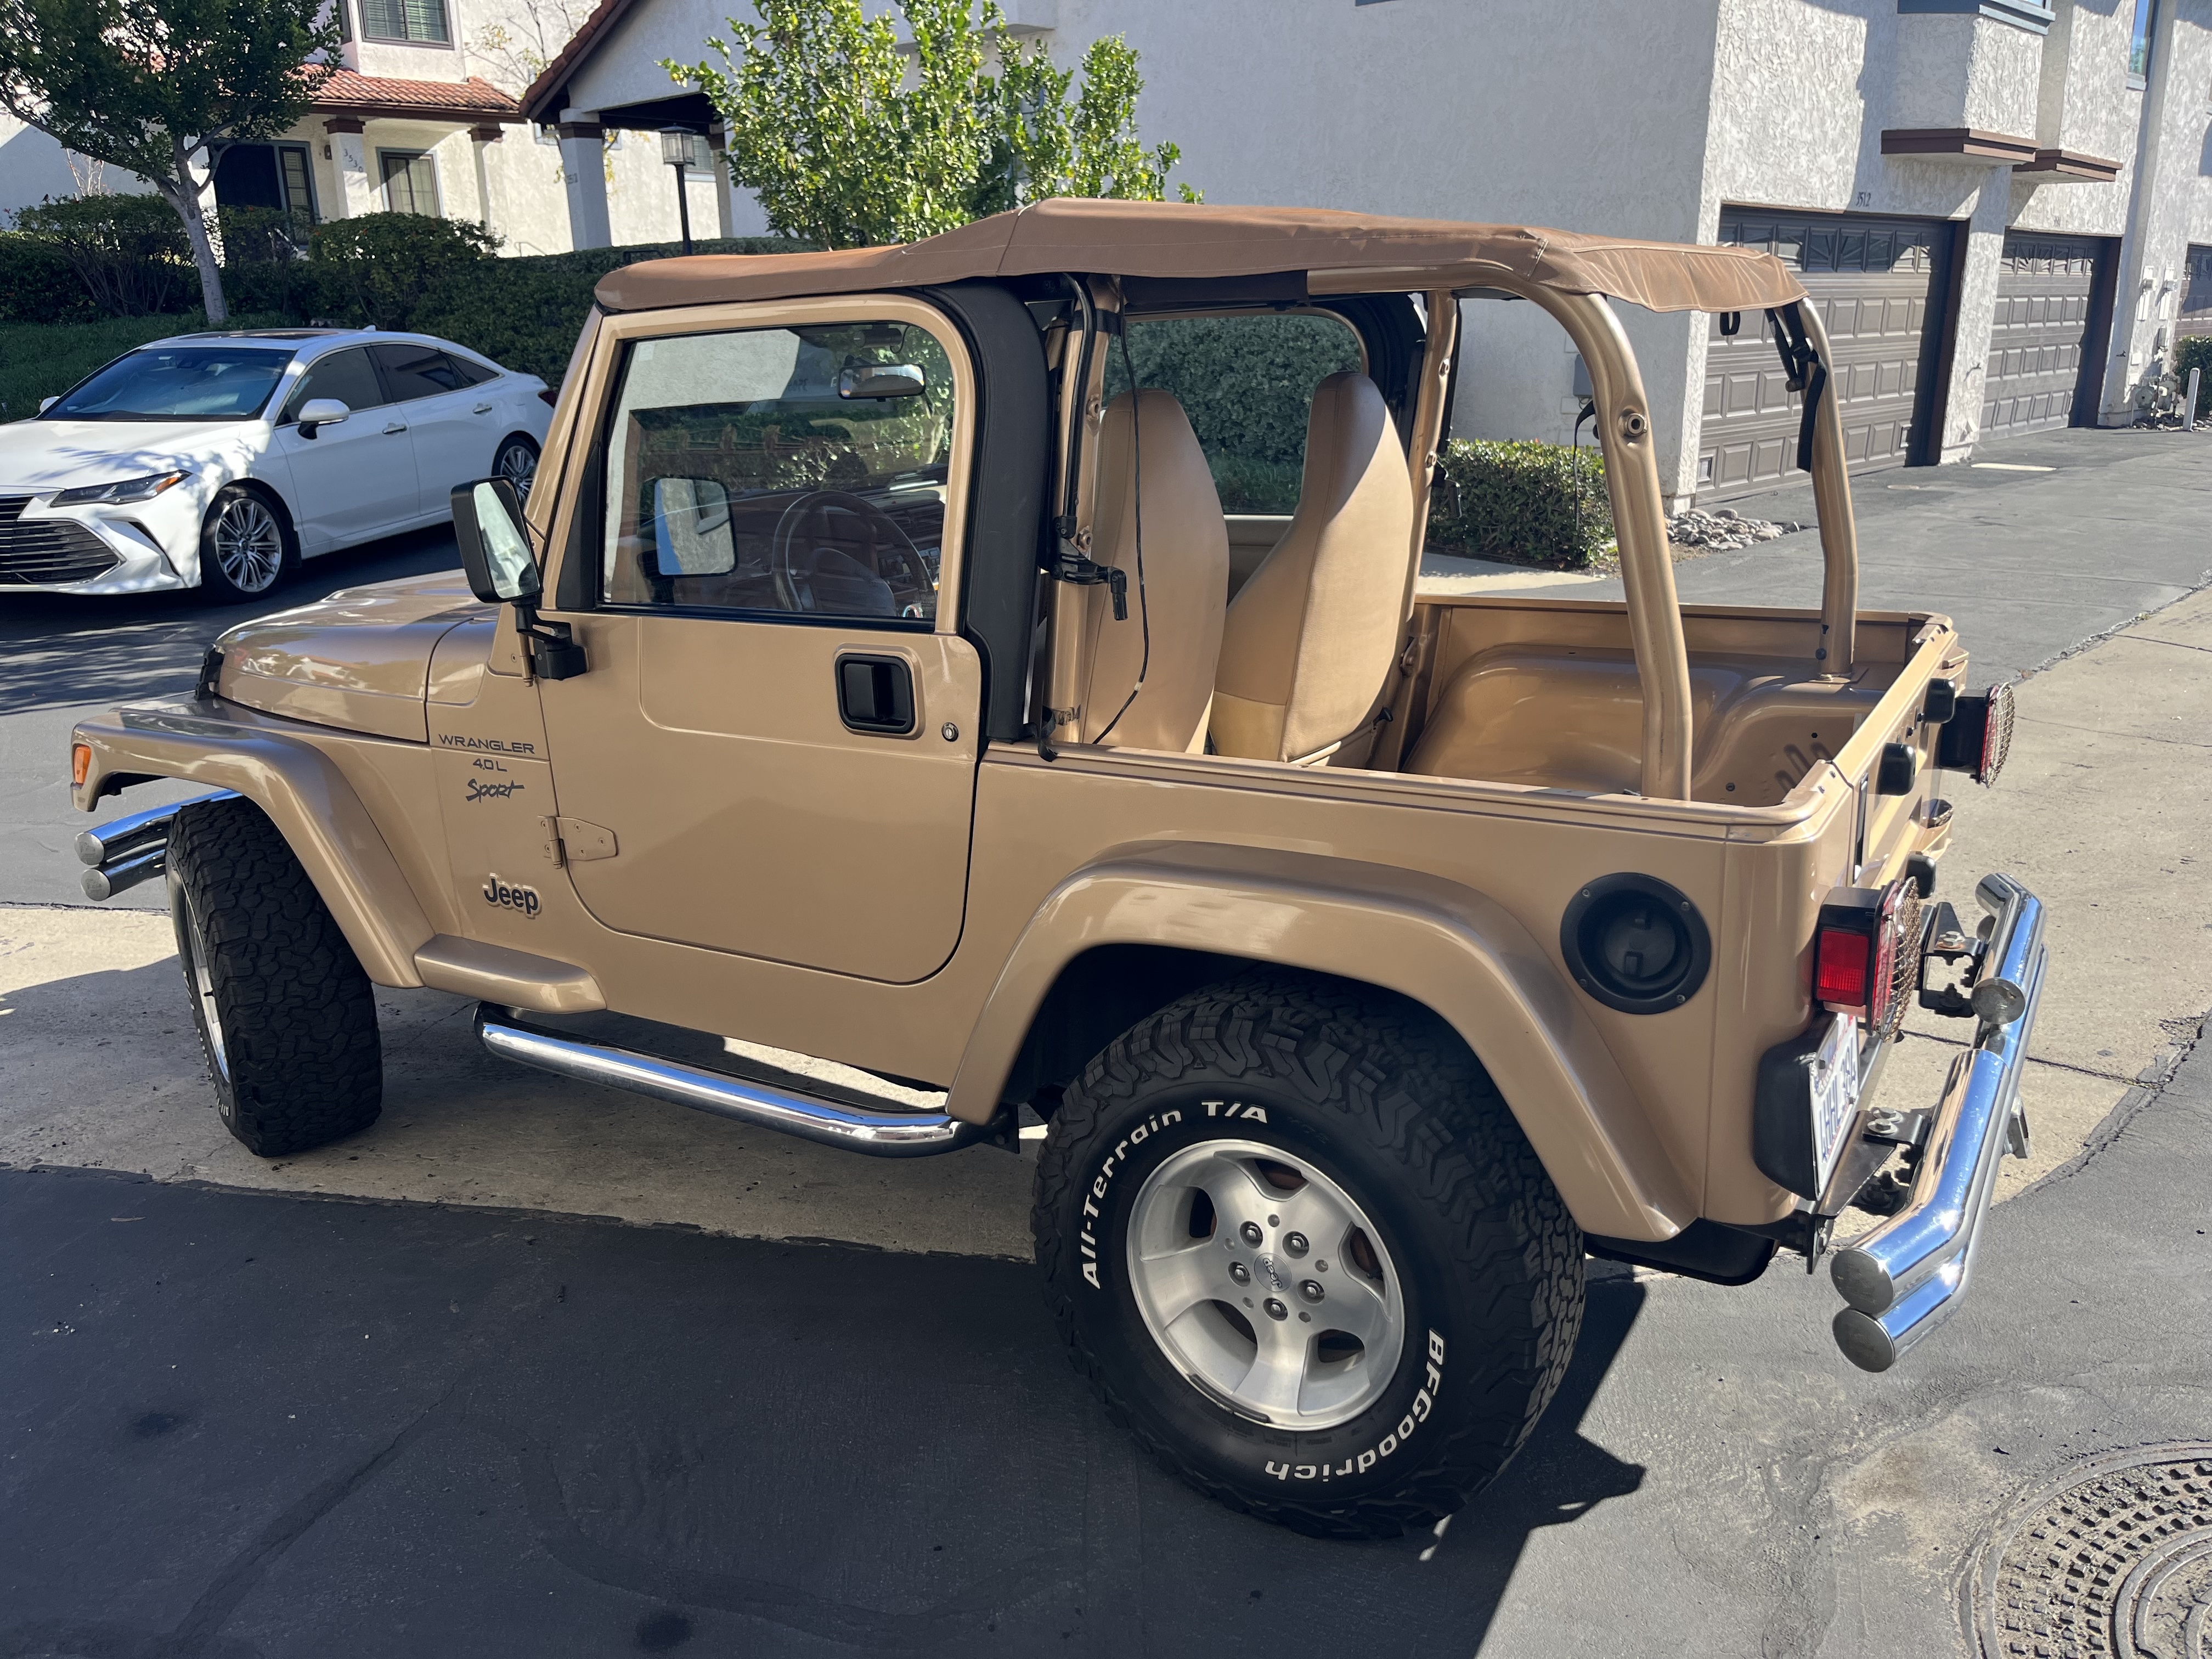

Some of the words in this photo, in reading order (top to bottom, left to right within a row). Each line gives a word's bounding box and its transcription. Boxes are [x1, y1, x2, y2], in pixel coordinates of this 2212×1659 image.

[438, 733, 535, 754] WRANGLER
[465, 778, 525, 804] Sport
[482, 873, 541, 919] Jeep
[1081, 1108, 1182, 1290] All-Terrain
[1201, 1101, 1268, 1124] T/A
[1263, 1257, 1283, 1288] Jeep
[1265, 1328, 1445, 1482] BFGoodrich
